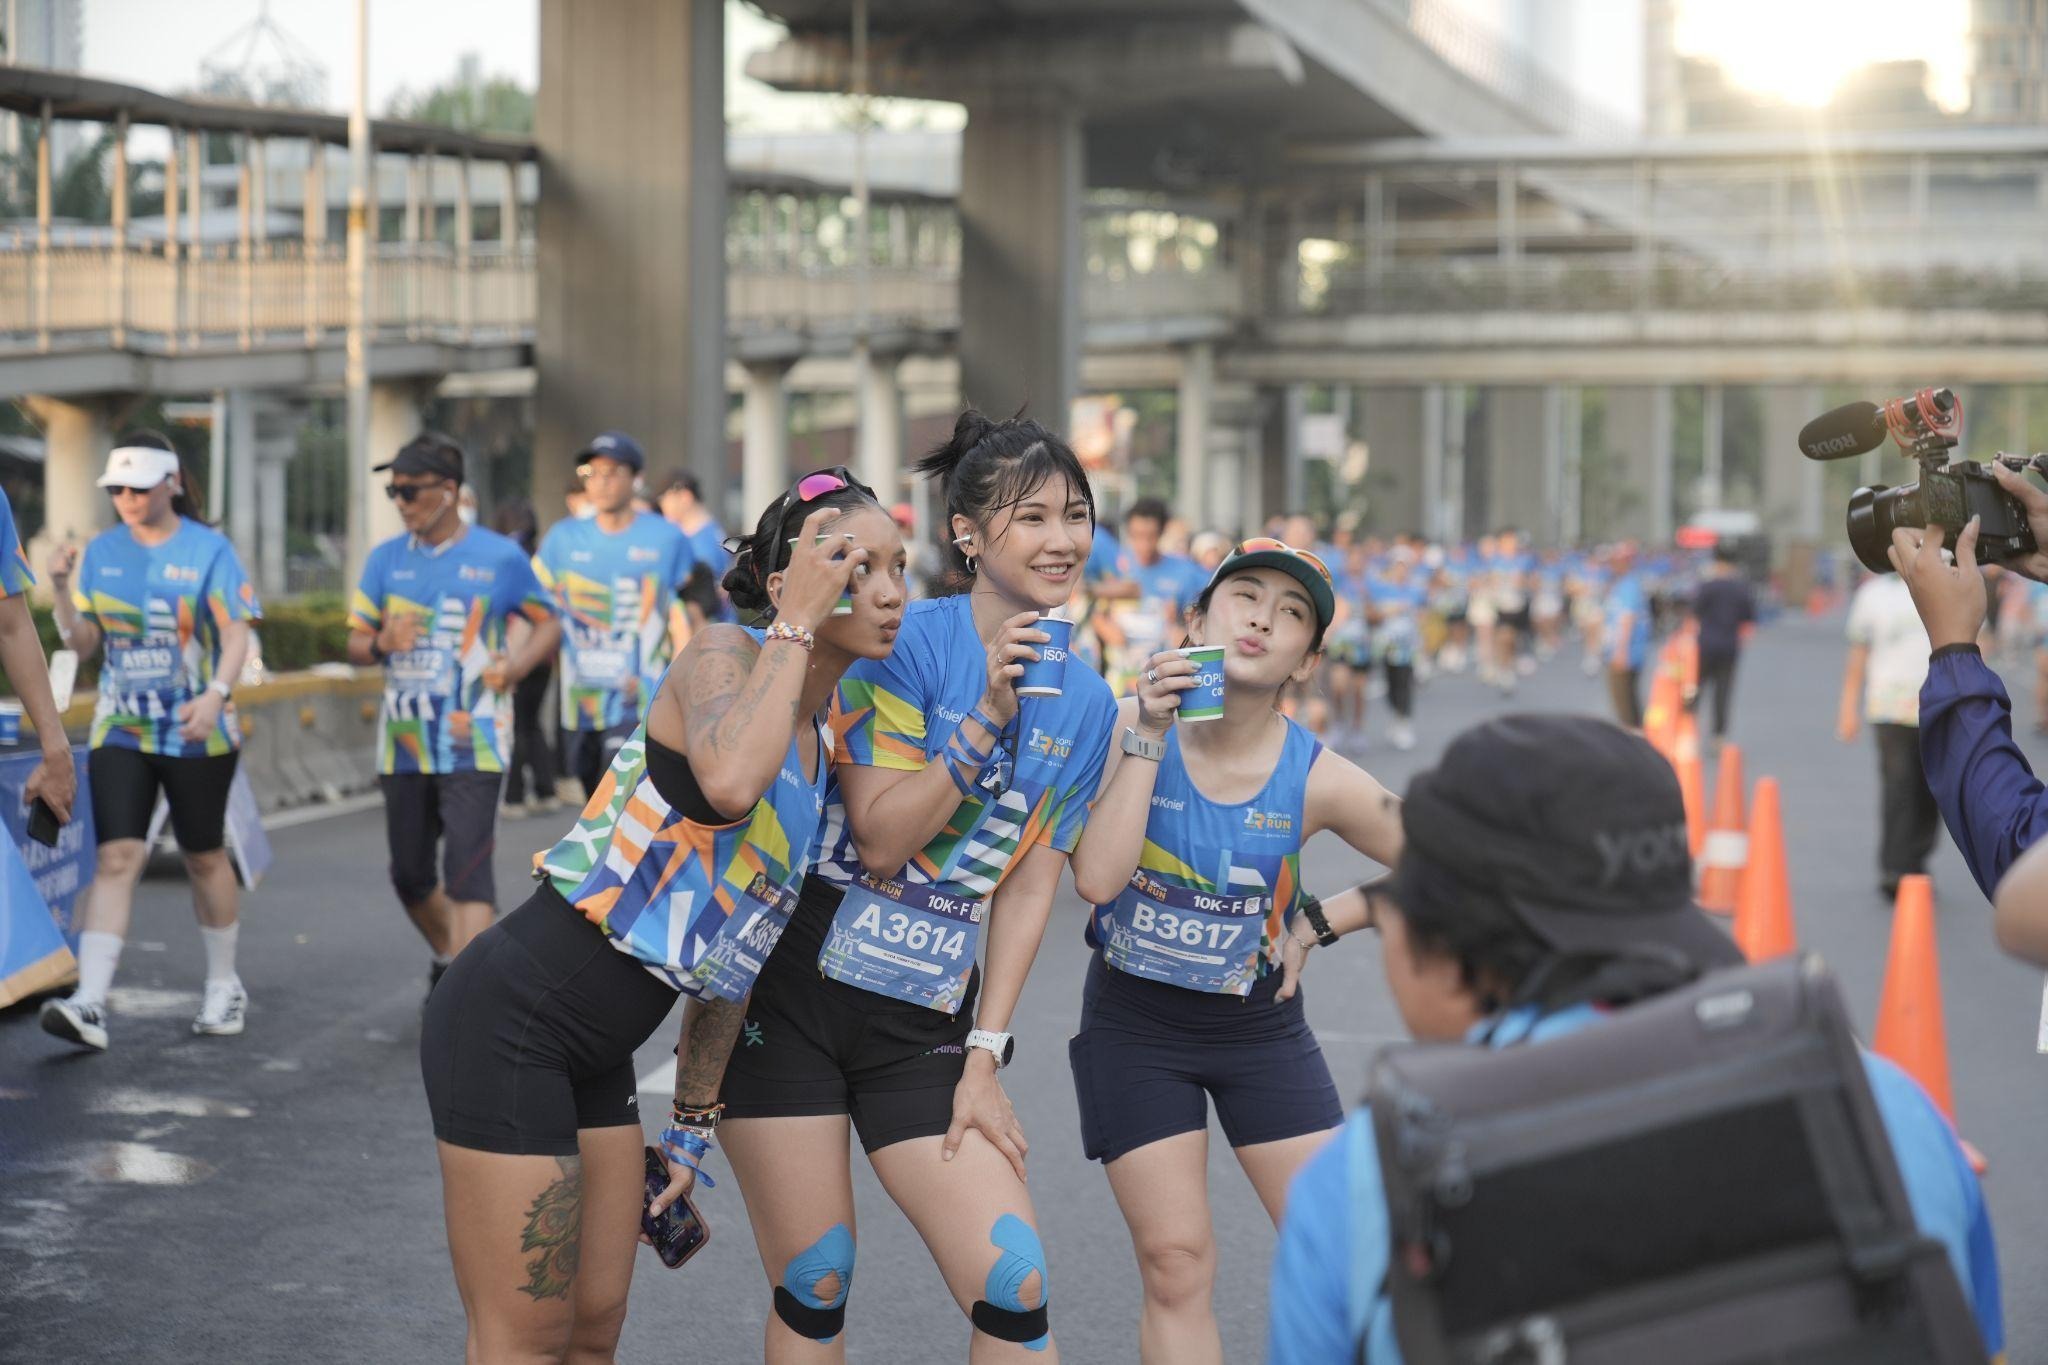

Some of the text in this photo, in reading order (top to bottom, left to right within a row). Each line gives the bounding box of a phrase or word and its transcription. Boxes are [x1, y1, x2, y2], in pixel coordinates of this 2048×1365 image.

[1267, 818, 1292, 830] RUN
[880, 882, 903, 897] RUN
[1147, 885, 1167, 900] RUN
[851, 903, 967, 961] A3614
[1131, 902, 1243, 950] B3617
